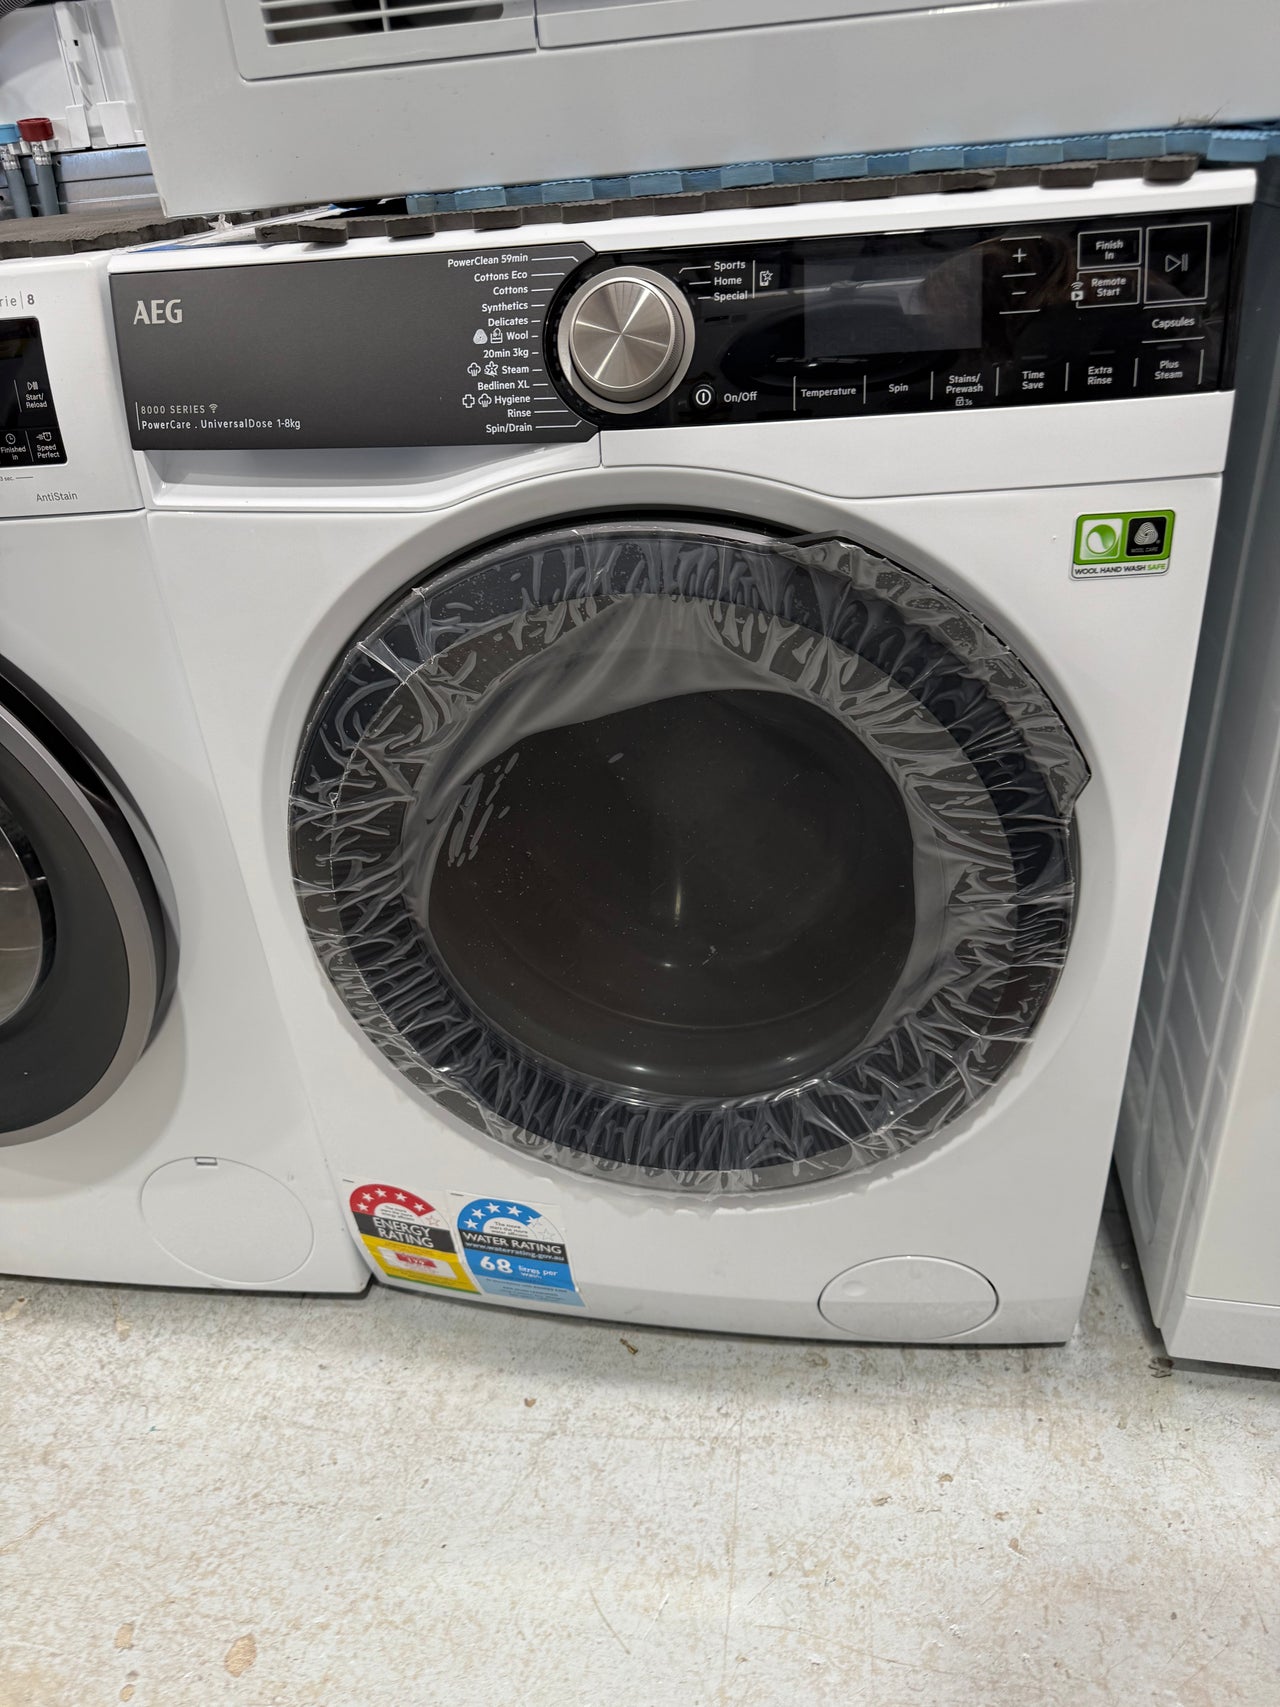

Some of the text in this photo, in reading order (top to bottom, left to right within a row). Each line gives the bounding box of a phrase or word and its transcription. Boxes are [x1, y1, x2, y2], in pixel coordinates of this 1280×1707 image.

[1095, 240, 1124, 251] Finish
[448, 253, 528, 268] PowerClean 59min
[713, 260, 746, 272] Sports
[474, 270, 528, 282] Cottons Eco
[714, 276, 742, 286] Home
[1091, 276, 1127, 287] Remote
[493, 286, 528, 295] Cottons
[1096, 287, 1121, 297] Start
[27, 293, 35, 305] 8
[713, 290, 748, 303] Special
[133, 299, 183, 325] AEG
[481, 301, 528, 314] Synthetics
[487, 317, 528, 327] Delicates
[1151, 316, 1196, 330] Capsules
[506, 330, 529, 340] Wool
[483, 348, 529, 358] 20min 3kg
[1159, 359, 1180, 369] Plus
[501, 365, 529, 375] Steam
[1021, 370, 1045, 380] Time
[1088, 365, 1113, 375] Extra
[1154, 369, 1183, 381] Steam
[948, 372, 981, 384] Stains/
[1087, 375, 1113, 385] Rinse
[477, 380, 530, 391] Bedlinen XL
[888, 383, 909, 393] Spin
[946, 383, 984, 394] Prewash
[1022, 380, 1044, 390] Save
[25, 392, 44, 401] Start/
[723, 391, 758, 403] On/Off
[800, 387, 857, 399] Temperature
[25, 401, 48, 409] Reload
[494, 395, 531, 406] Hygiene
[140, 404, 206, 415] 8000 SERIES
[507, 408, 532, 418] Rinse
[141, 420, 191, 430] PowerCare
[201, 418, 273, 429] UniversalDose
[276, 418, 301, 430] 1-8kg
[486, 422, 533, 435] Spin/Drain
[36, 443, 57, 452] Speed
[37, 451, 61, 459] Perfect
[36, 490, 79, 502] AntiStain
[1074, 563, 1167, 576] WOOL HAND WASH SAFE
[372, 1216, 431, 1237] ENERGY
[378, 1228, 435, 1248] RATING
[462, 1231, 562, 1254] WATER RATING
[480, 1255, 513, 1274] 68
[542, 1269, 558, 1277] per
